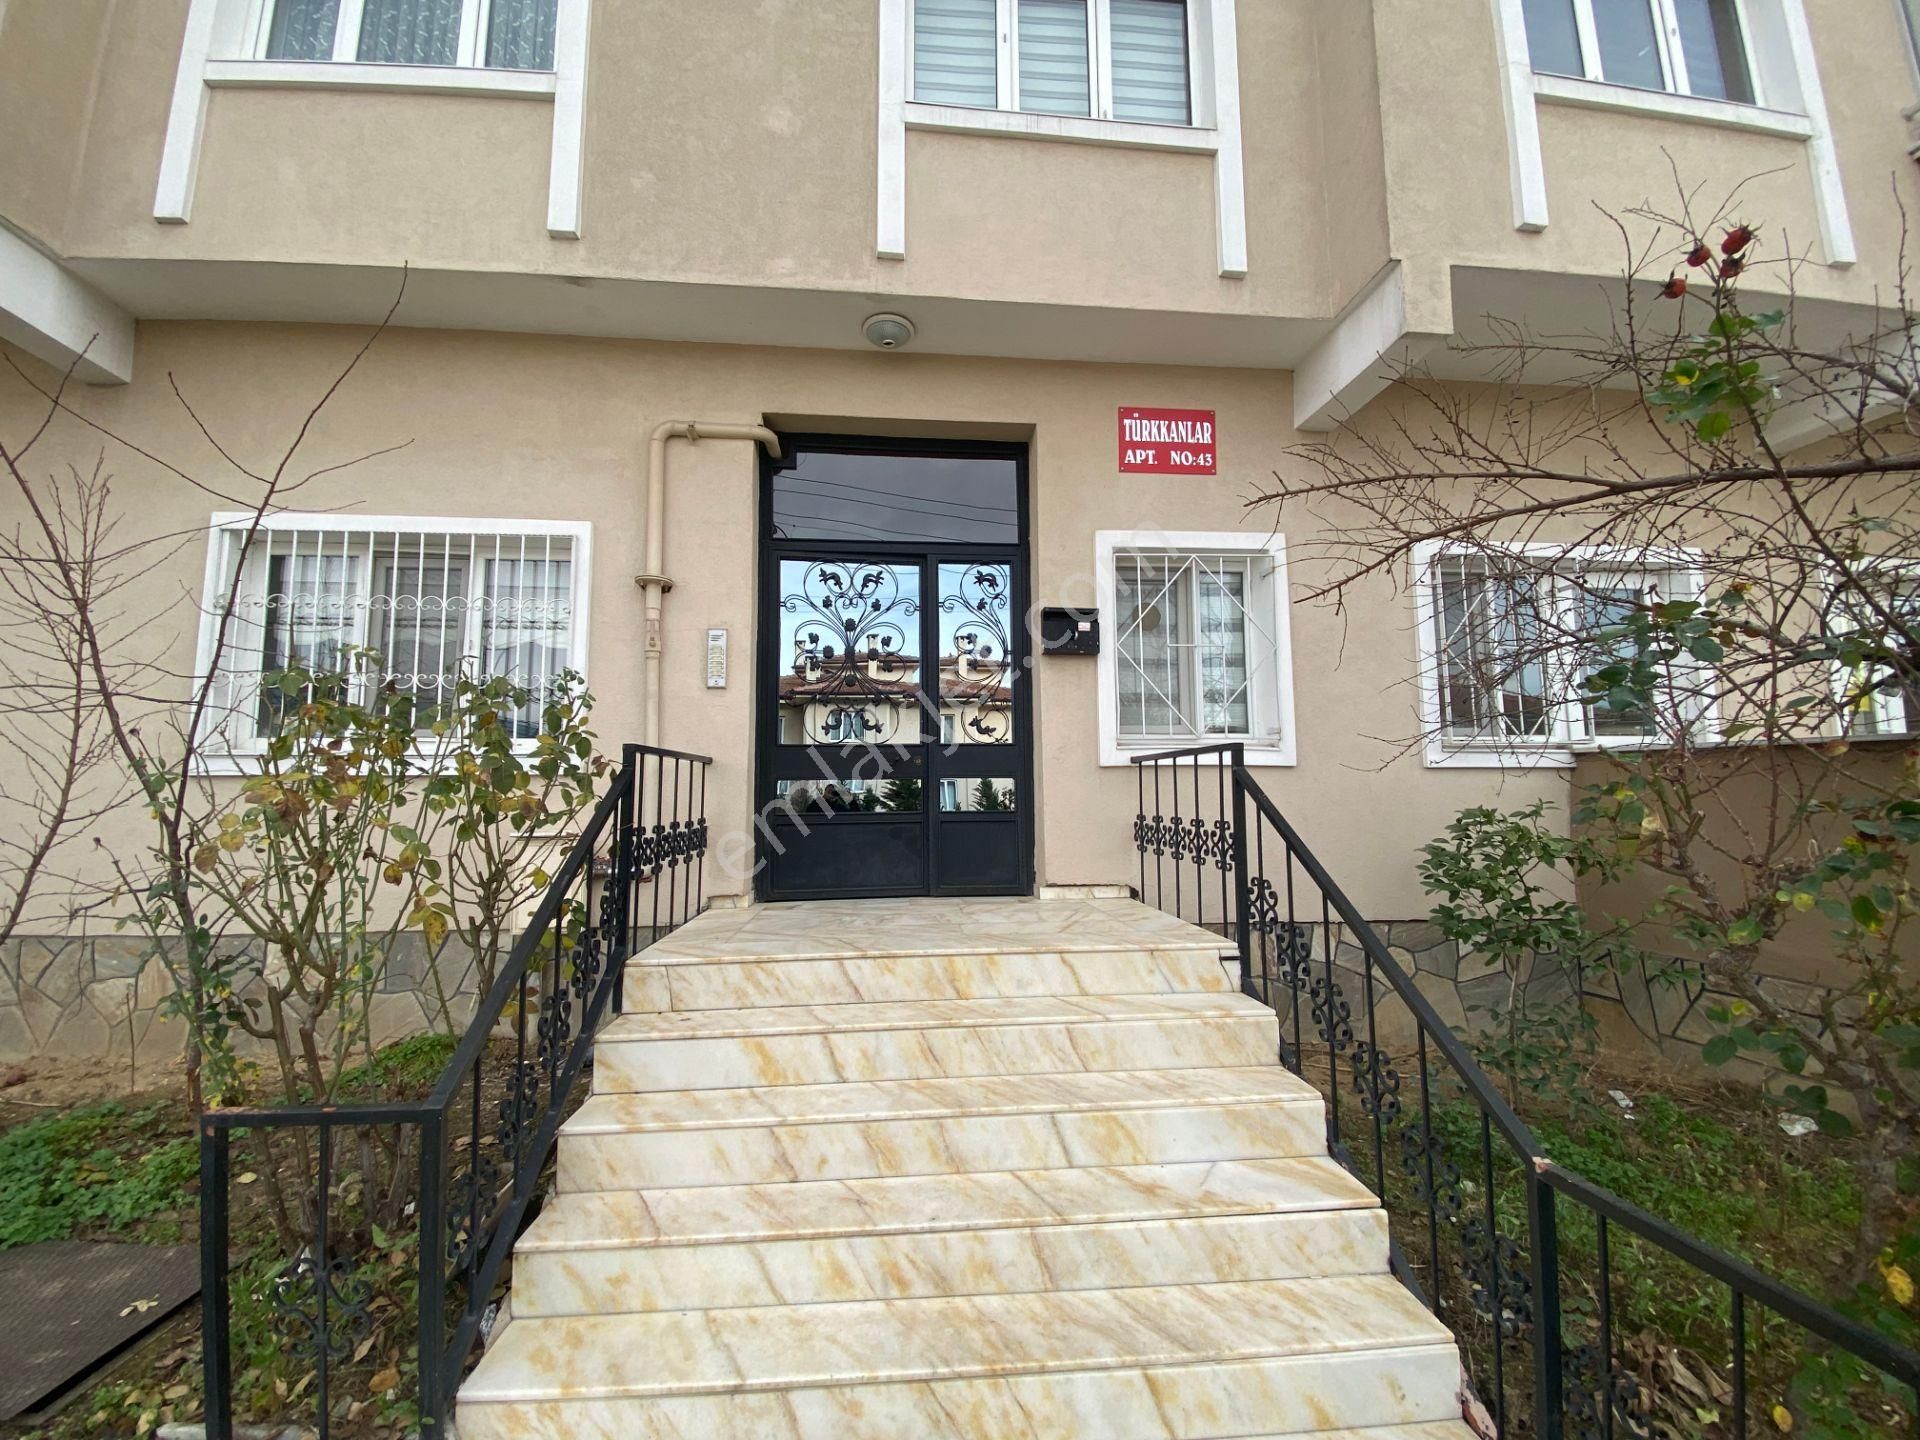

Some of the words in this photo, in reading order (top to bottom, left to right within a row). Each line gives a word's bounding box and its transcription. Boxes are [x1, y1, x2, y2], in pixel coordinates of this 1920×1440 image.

[1123, 412, 1212, 444] TÜRKKANLAR
[1124, 449, 1158, 465] APT.
[1170, 450, 1213, 466] NO:43
